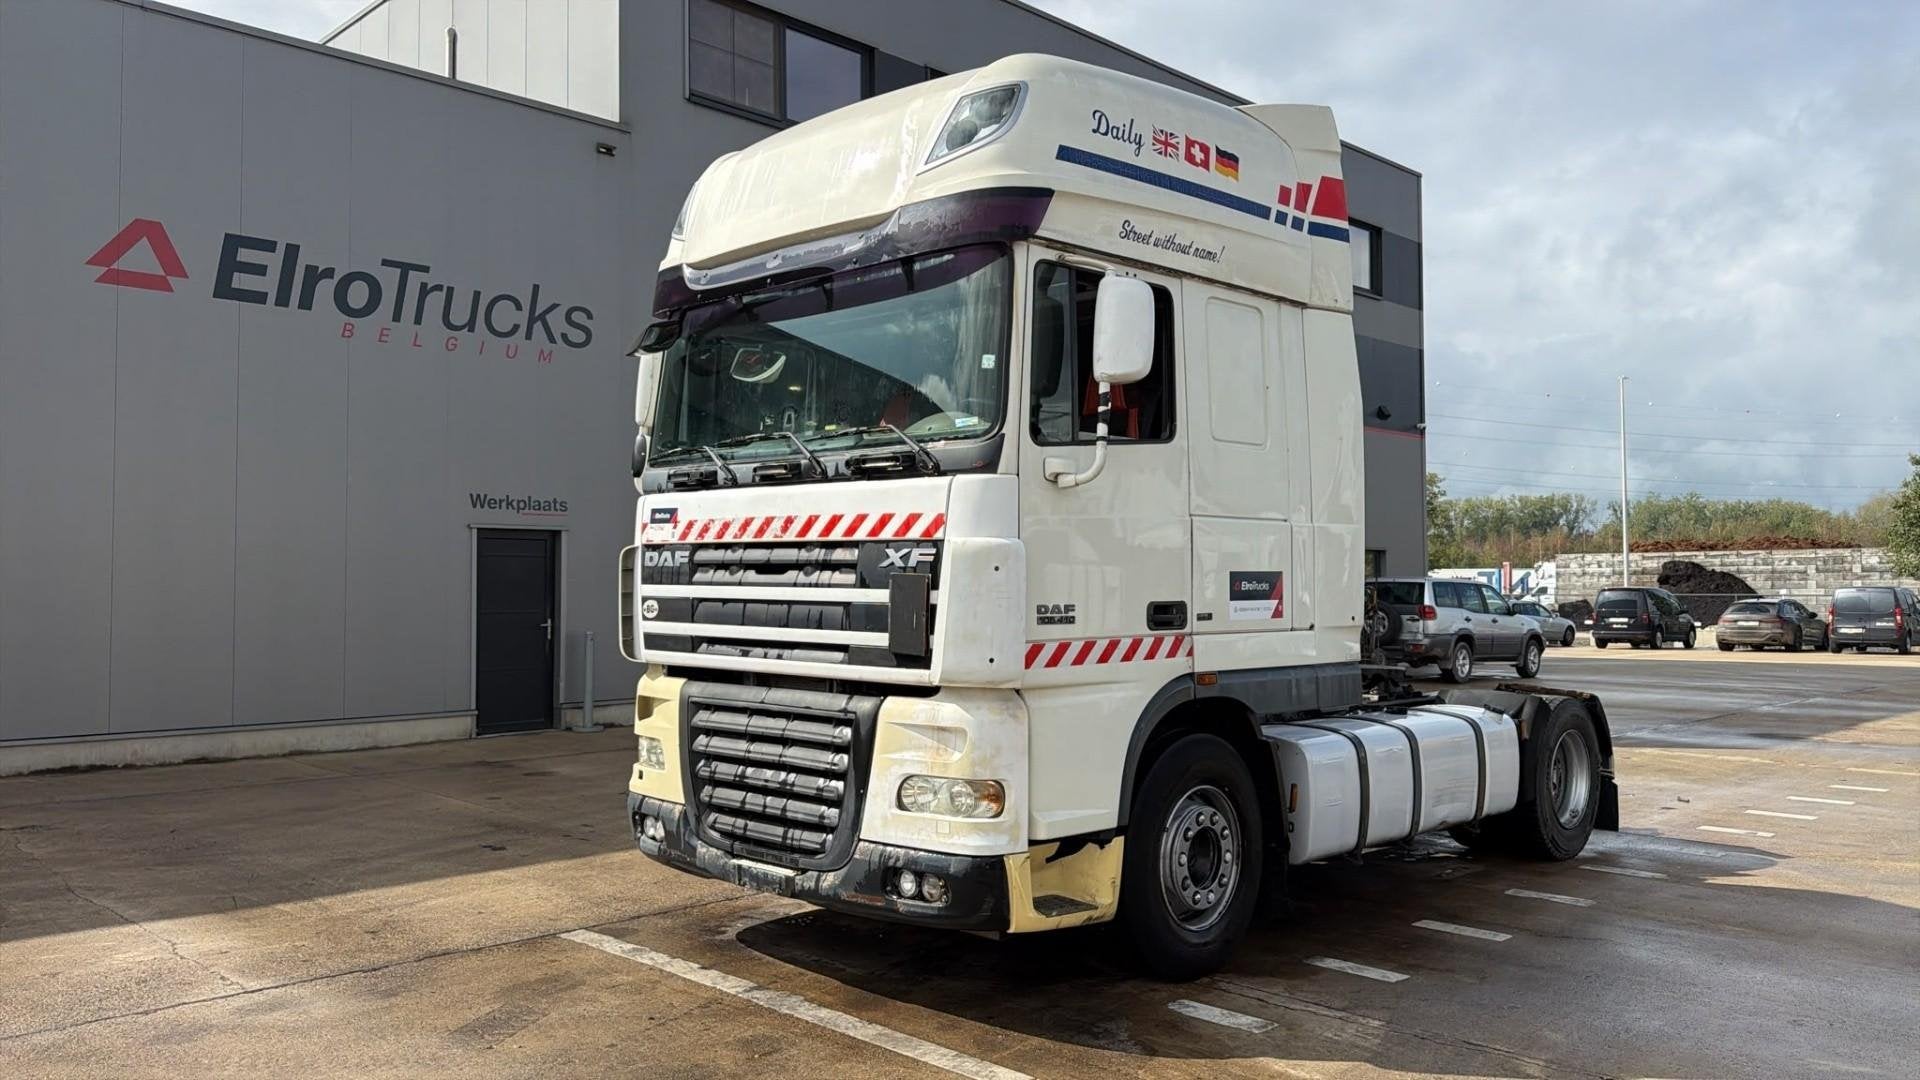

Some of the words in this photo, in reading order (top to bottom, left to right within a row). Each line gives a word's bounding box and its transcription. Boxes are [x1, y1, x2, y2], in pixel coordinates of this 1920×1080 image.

[1092, 109, 1145, 157] Daily
[1119, 218, 1154, 246] Street
[1153, 232, 1195, 256] without
[1192, 245, 1226, 263] name!
[212, 232, 594, 350] ElroTrucks
[341, 321, 556, 364] BELGIUM
[469, 493, 568, 514] Werkplaats
[644, 550, 691, 567] DAF
[879, 547, 937, 568] XF
[1036, 604, 1076, 615] DAF
